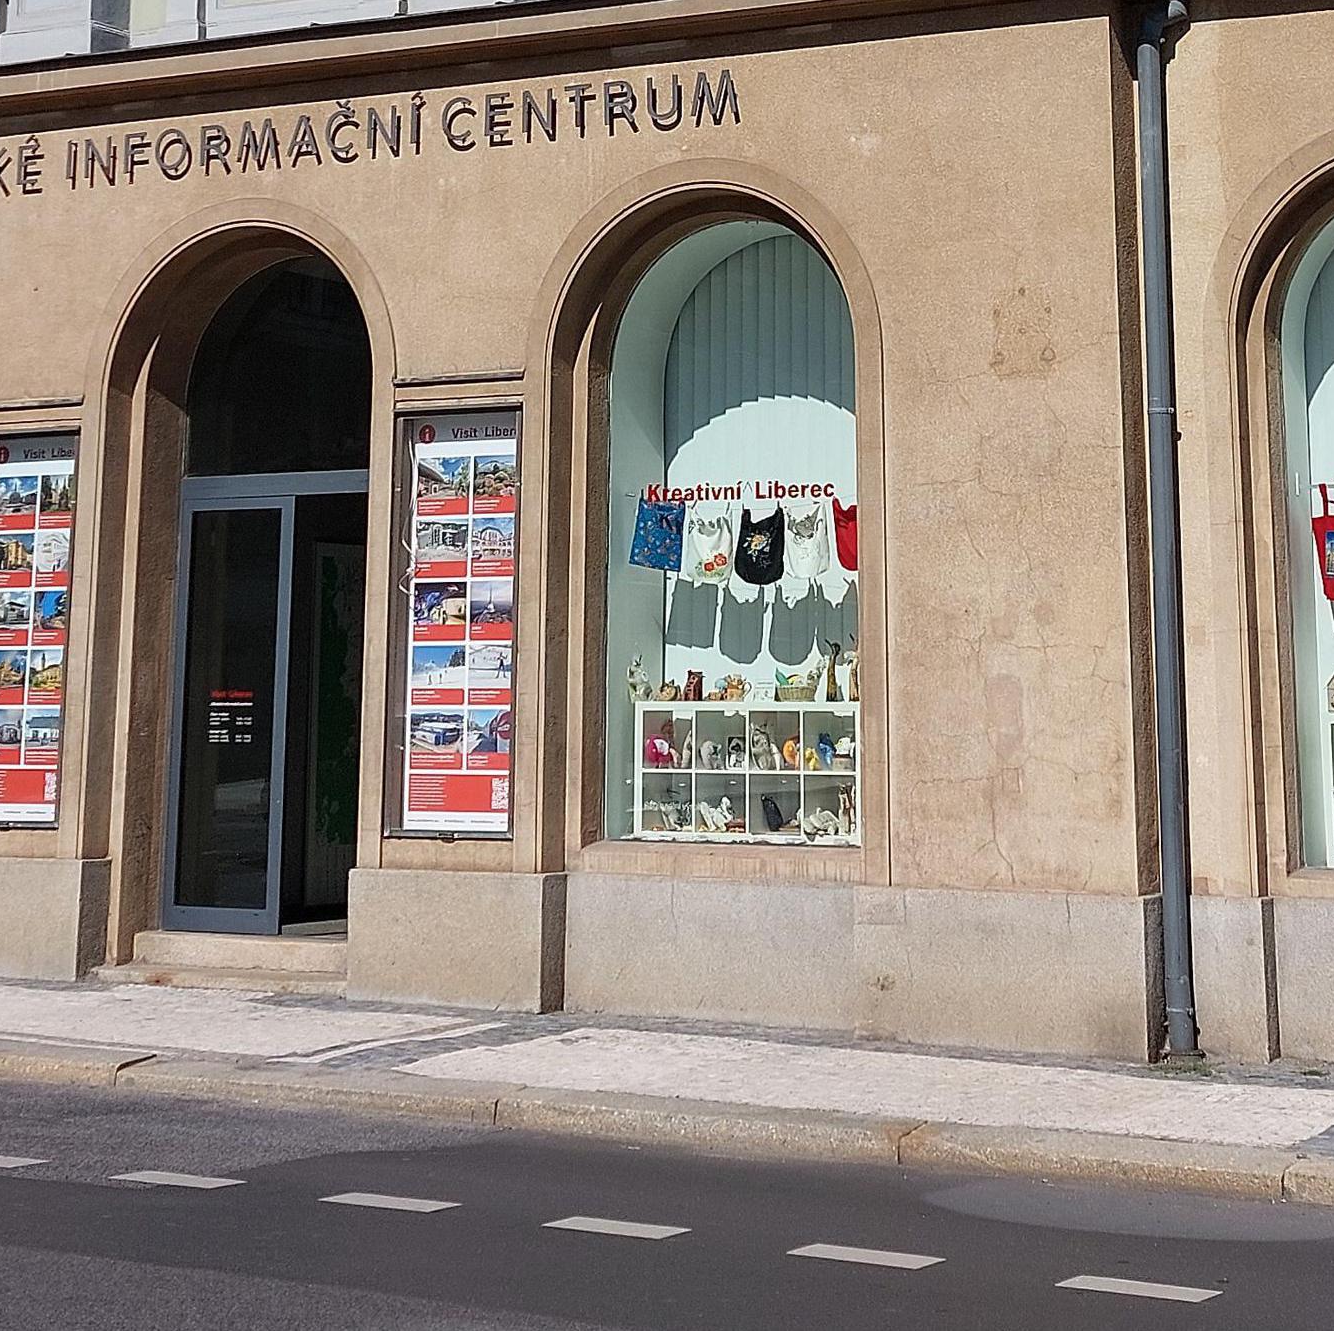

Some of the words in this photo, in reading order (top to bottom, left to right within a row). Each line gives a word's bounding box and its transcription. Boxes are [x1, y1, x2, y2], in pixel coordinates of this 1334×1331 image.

[67, 93, 423, 186] INFORMAČNÍ
[441, 69, 740, 148] CENTRUM
[452, 427, 478, 438] Visit
[23, 449, 44, 459] Visit
[646, 481, 742, 502] Kreativní
[755, 481, 835, 500] Liberec
